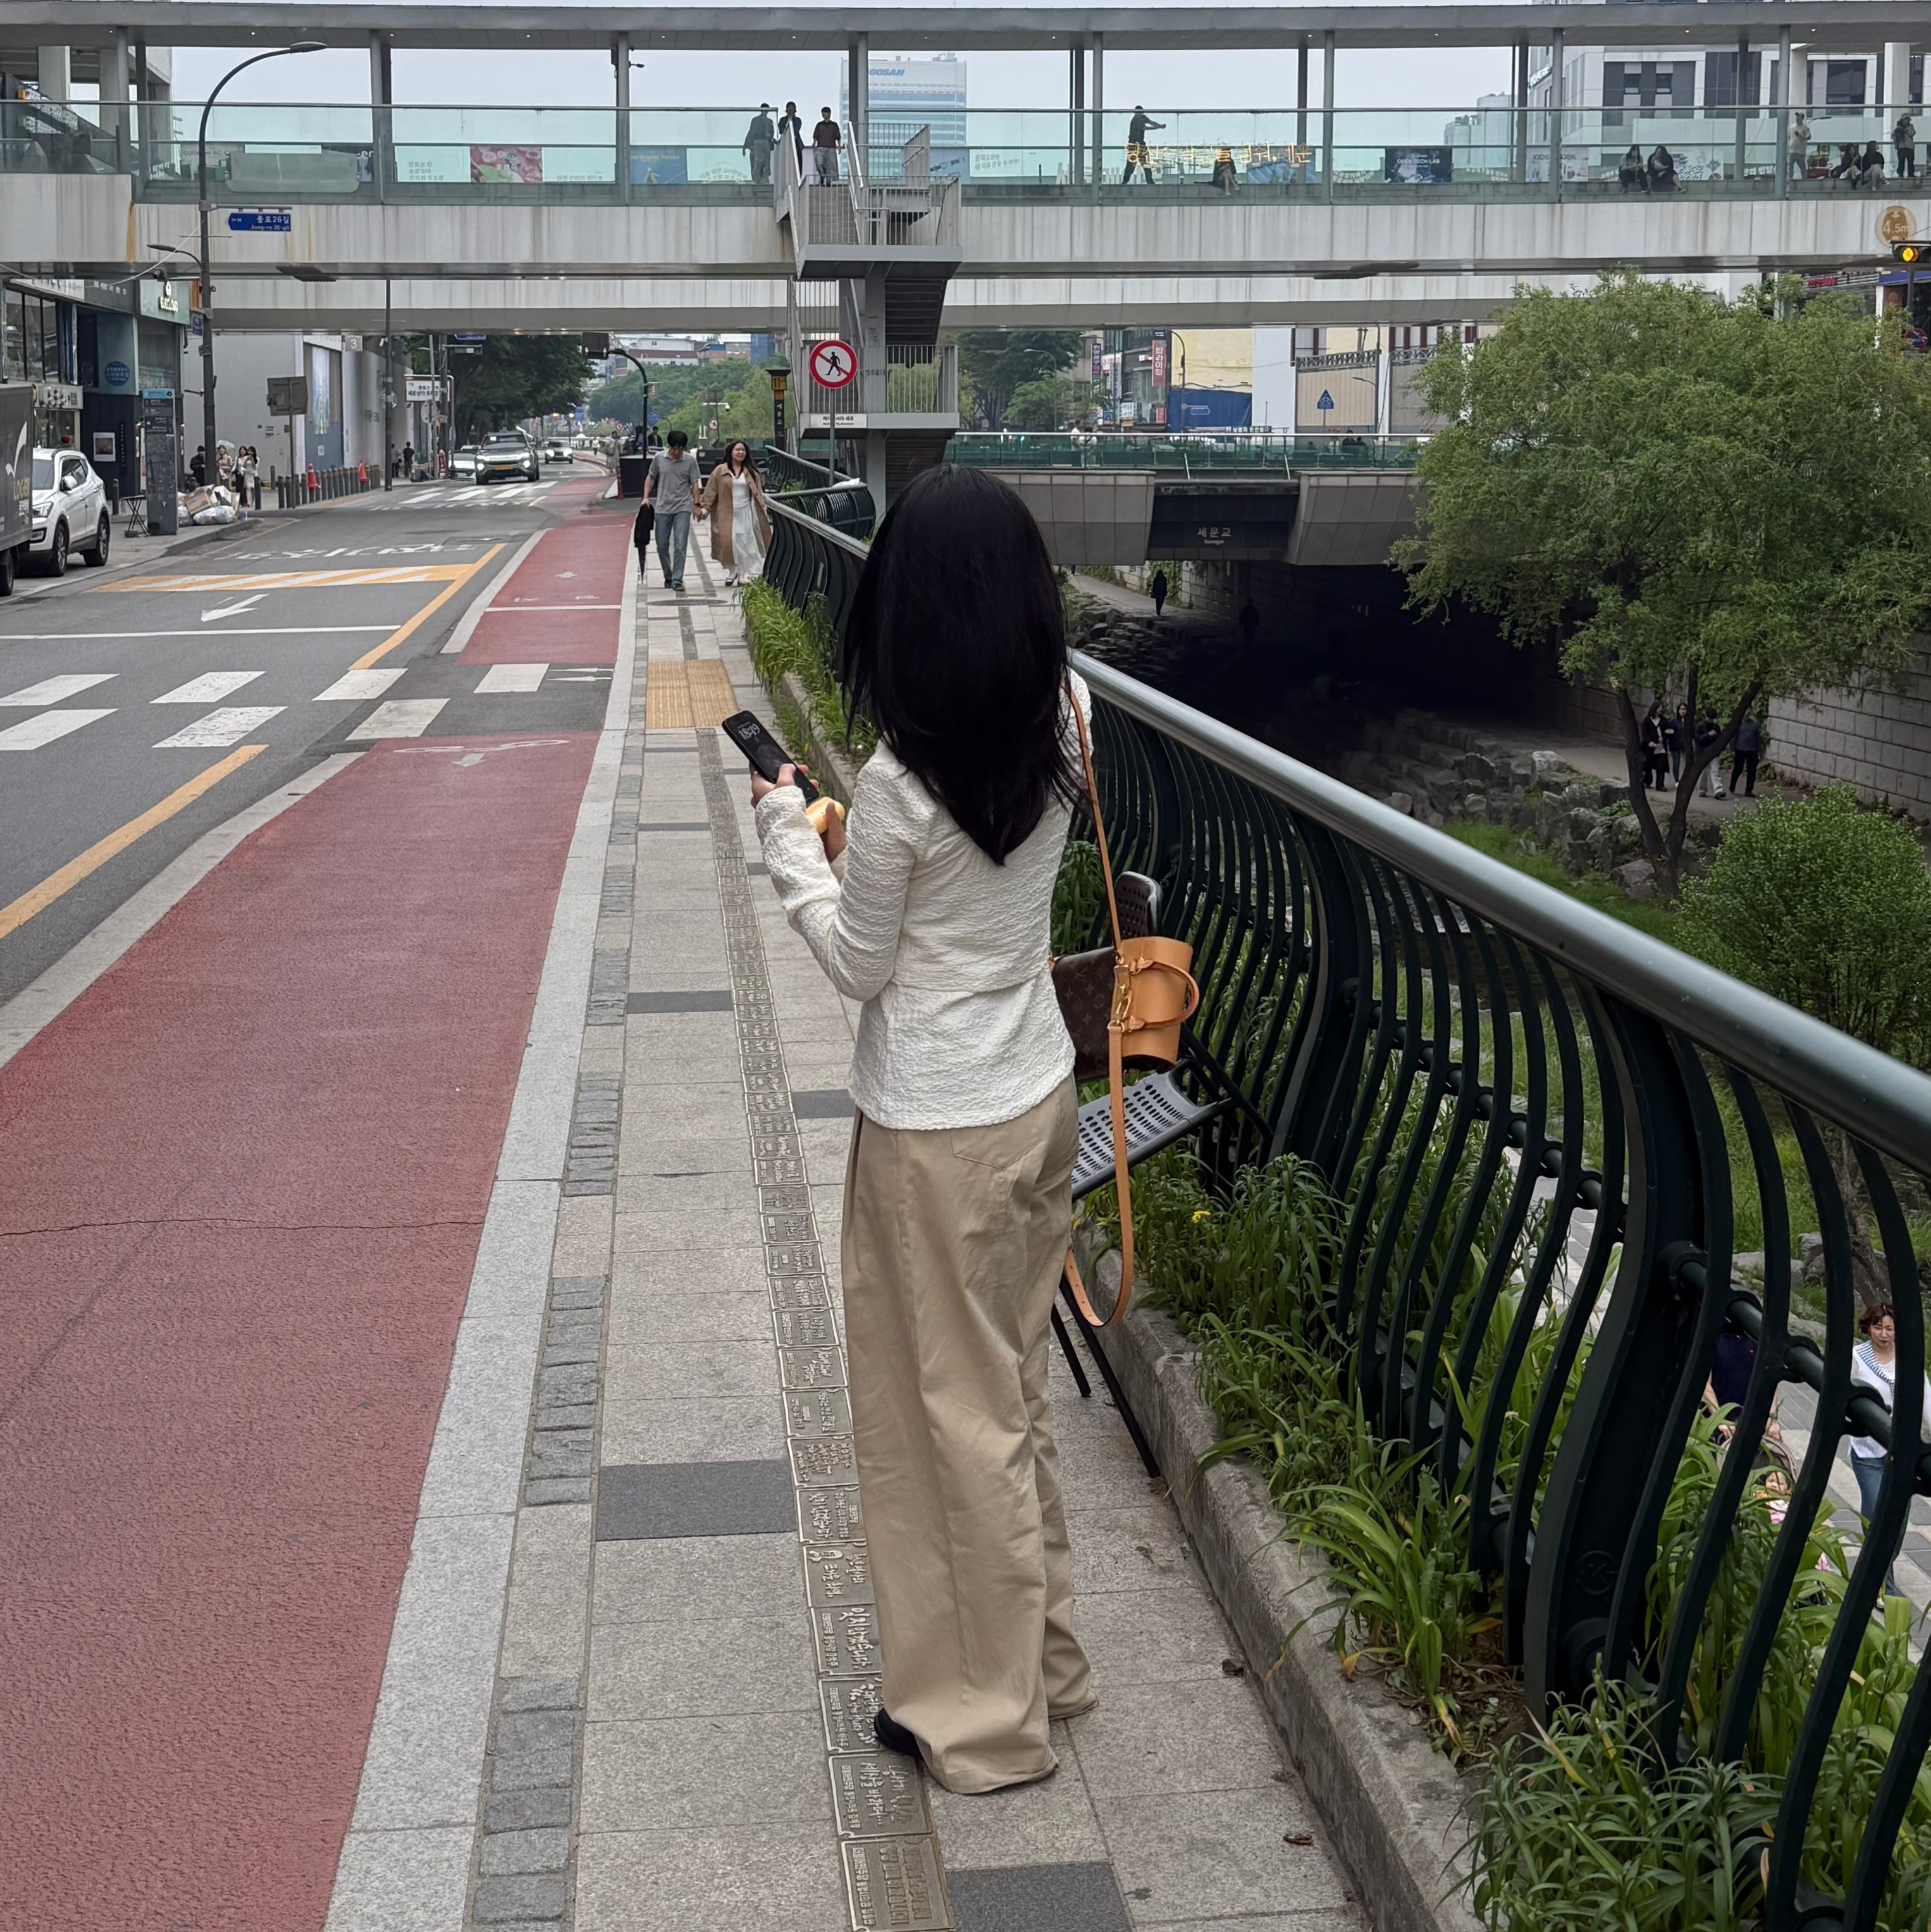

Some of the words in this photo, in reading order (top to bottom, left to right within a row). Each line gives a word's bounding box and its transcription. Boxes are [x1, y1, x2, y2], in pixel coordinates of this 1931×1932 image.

[256, 215, 290, 224] 종로26길
[1883, 220, 1908, 233] 4.5m
[351, 339, 357, 349] 3
[1197, 527, 1231, 538] 세운교
[840, 1765, 854, 1790] 더불어민주당
[857, 1761, 884, 1788] 세상을
[851, 1847, 870, 1881] 더불어민주당
